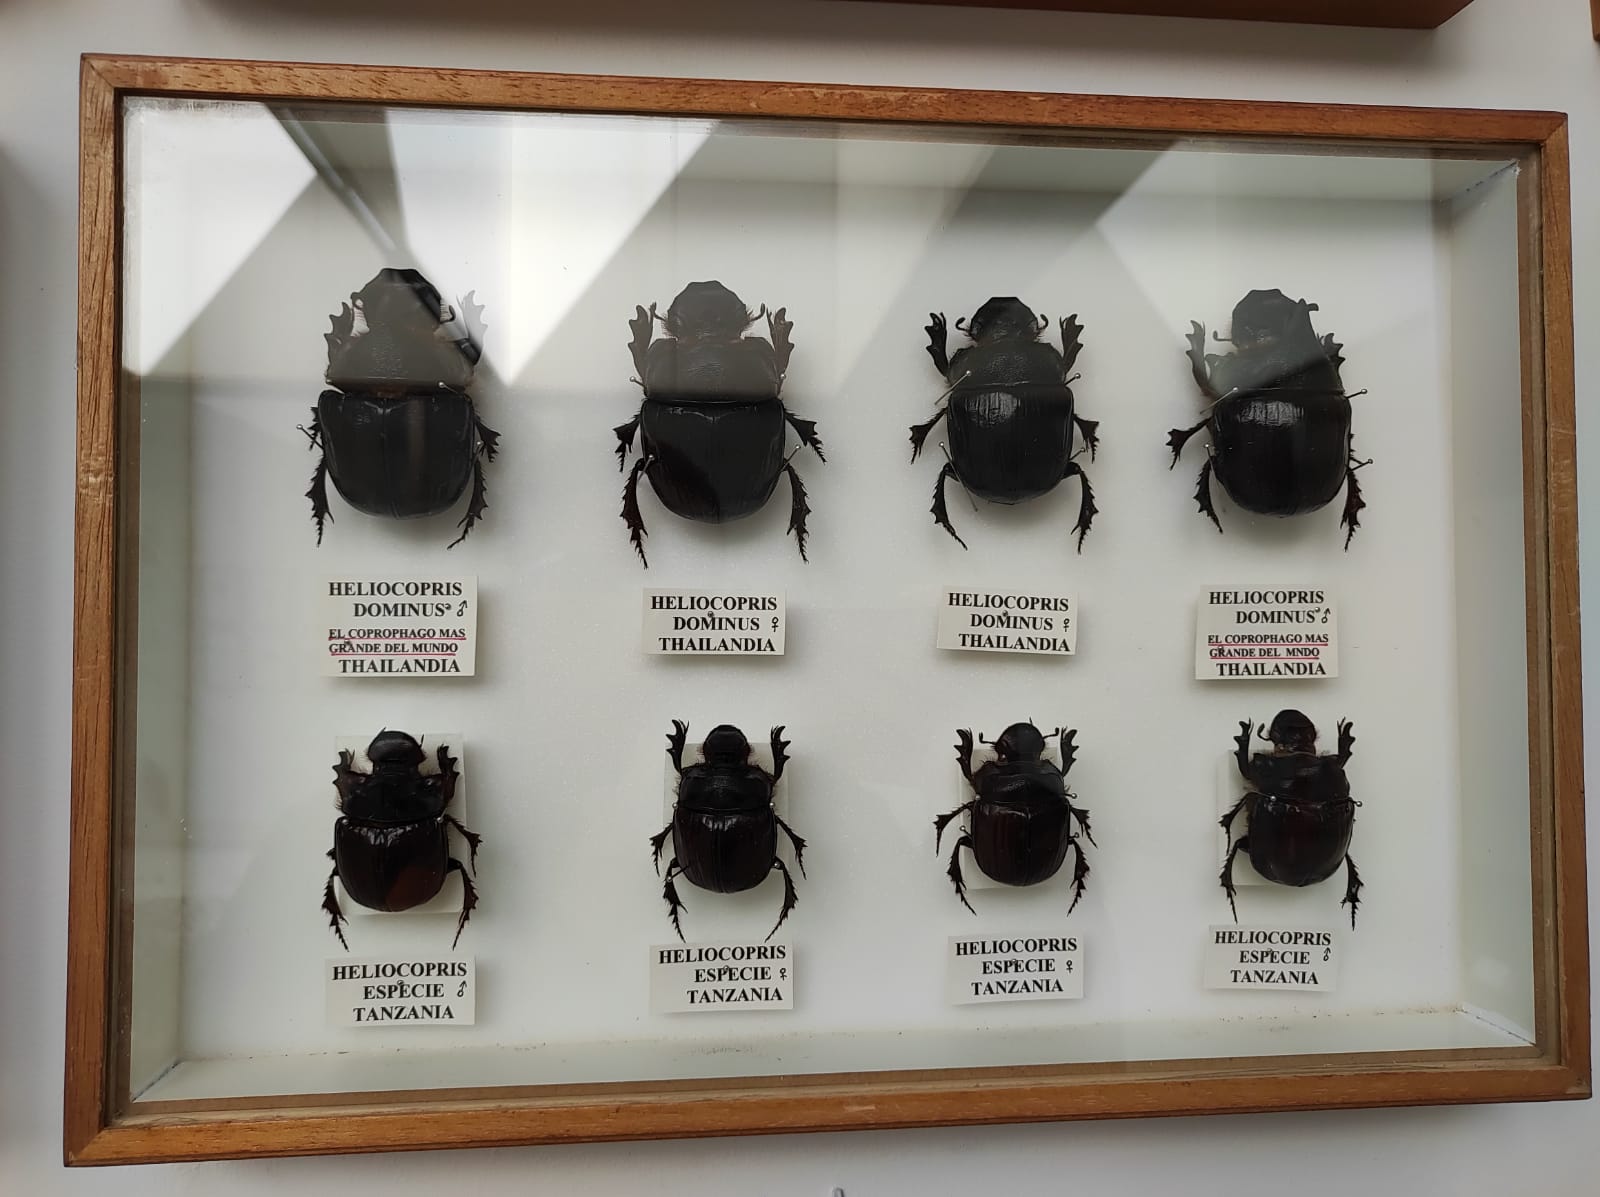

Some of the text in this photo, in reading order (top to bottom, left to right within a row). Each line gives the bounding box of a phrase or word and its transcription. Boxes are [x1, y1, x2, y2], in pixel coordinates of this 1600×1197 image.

[328, 582, 462, 596] HELIOCOPRIS
[650, 596, 777, 610] HELIOCOPRIS
[948, 593, 1069, 611] HELIOCOPRIS
[1209, 591, 1324, 604] HELIOCOPRIS
[354, 603, 445, 616] DOMINUS
[673, 617, 760, 630] DOMINUS
[971, 614, 1053, 630] DOMINUS
[1236, 611, 1315, 623] DOMINUS
[329, 629, 465, 638] EL COPROPHAGO MAS
[1208, 634, 1328, 643] EL COPROPHAGO MAS
[329, 643, 458, 652] GRANDE DEL MUNDO
[659, 638, 775, 651] THAILANDIA
[959, 634, 1070, 651] THAILANDIA
[1210, 648, 1255, 657] GRANDE
[1286, 648, 1319, 656] MNDO
[339, 659, 460, 673] THAILANDIA
[1216, 663, 1326, 676] THAILANDIA
[1215, 931, 1331, 946] HELIOCOPRIS
[956, 938, 1077, 955] HELIOCOPRIS
[659, 945, 786, 963] HELIOCOPRIS
[1240, 950, 1310, 964] ESPECIE
[333, 963, 467, 980] HELIOCOPRIS
[982, 959, 1055, 974] ESPECIE
[695, 967, 771, 982] ESPECIE
[1231, 970, 1318, 984] TANZANIA
[364, 984, 444, 1000] ESPECIE
[971, 979, 1063, 995] TANZANIA
[687, 987, 783, 1003] TANZANIA
[353, 1005, 454, 1021] TANZANIA
